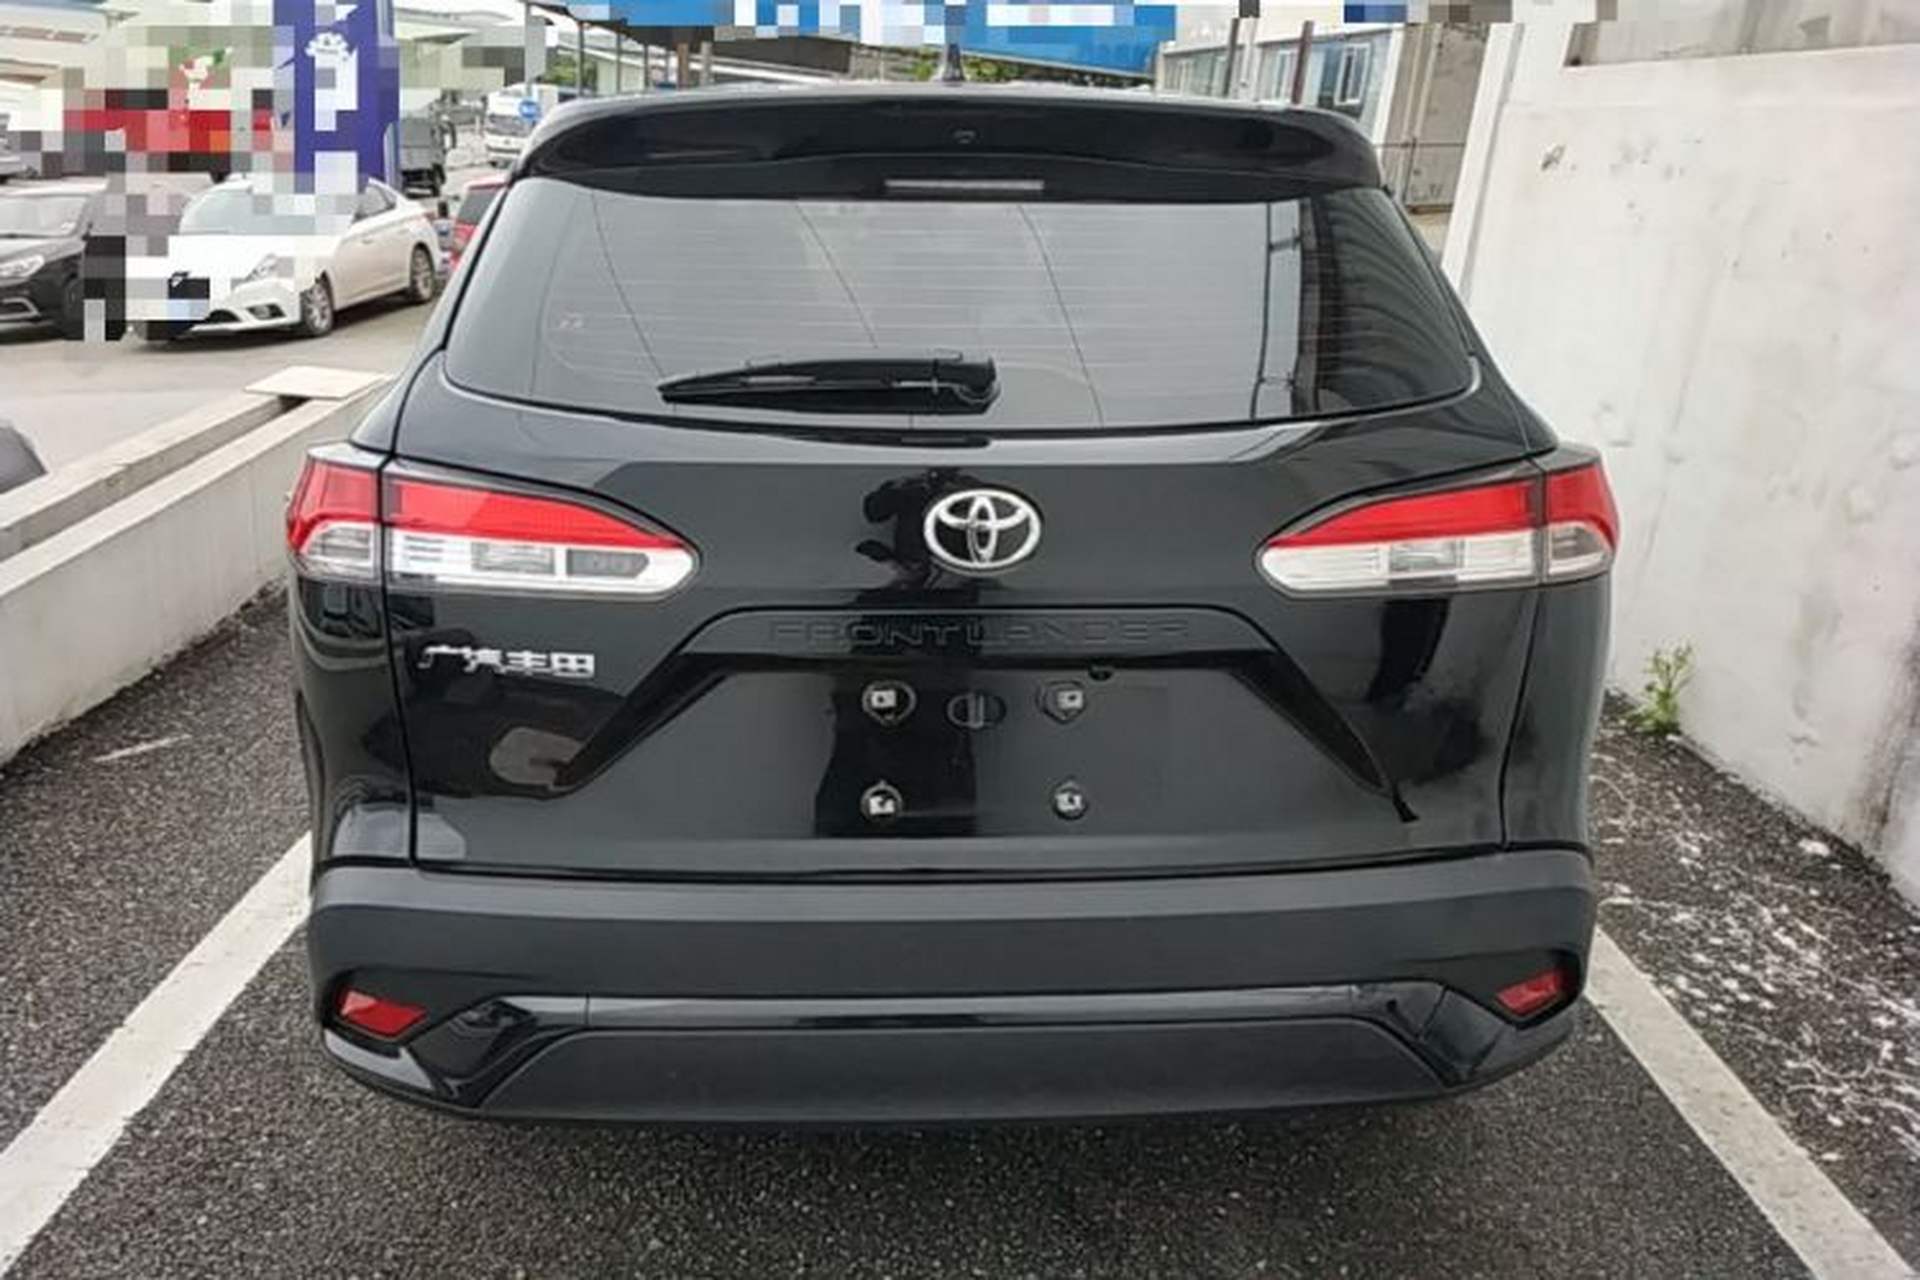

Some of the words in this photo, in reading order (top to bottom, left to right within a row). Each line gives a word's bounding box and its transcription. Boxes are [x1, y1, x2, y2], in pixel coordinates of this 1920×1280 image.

[770, 614, 1189, 648] FRONTLANDER
[418, 645, 594, 678] 广汽丰田
